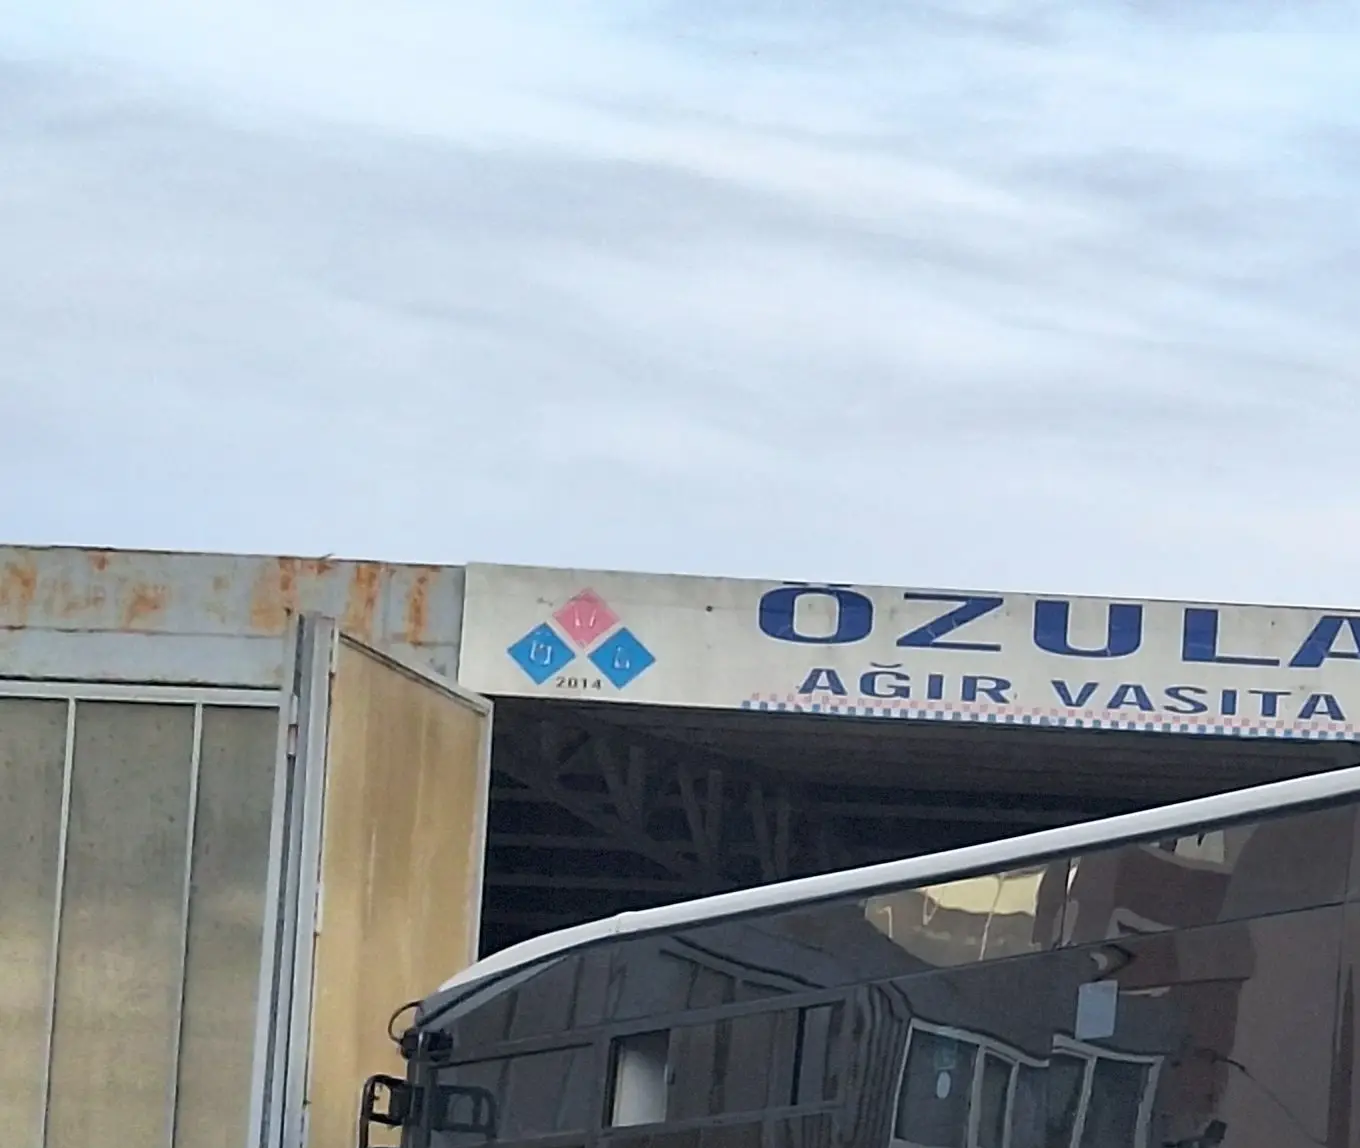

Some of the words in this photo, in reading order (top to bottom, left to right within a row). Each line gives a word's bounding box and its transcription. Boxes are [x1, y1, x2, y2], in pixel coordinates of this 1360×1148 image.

[555, 676, 602, 691] 2014
[798, 662, 1013, 705] AĞIR
[1051, 679, 1347, 722] VASITA
